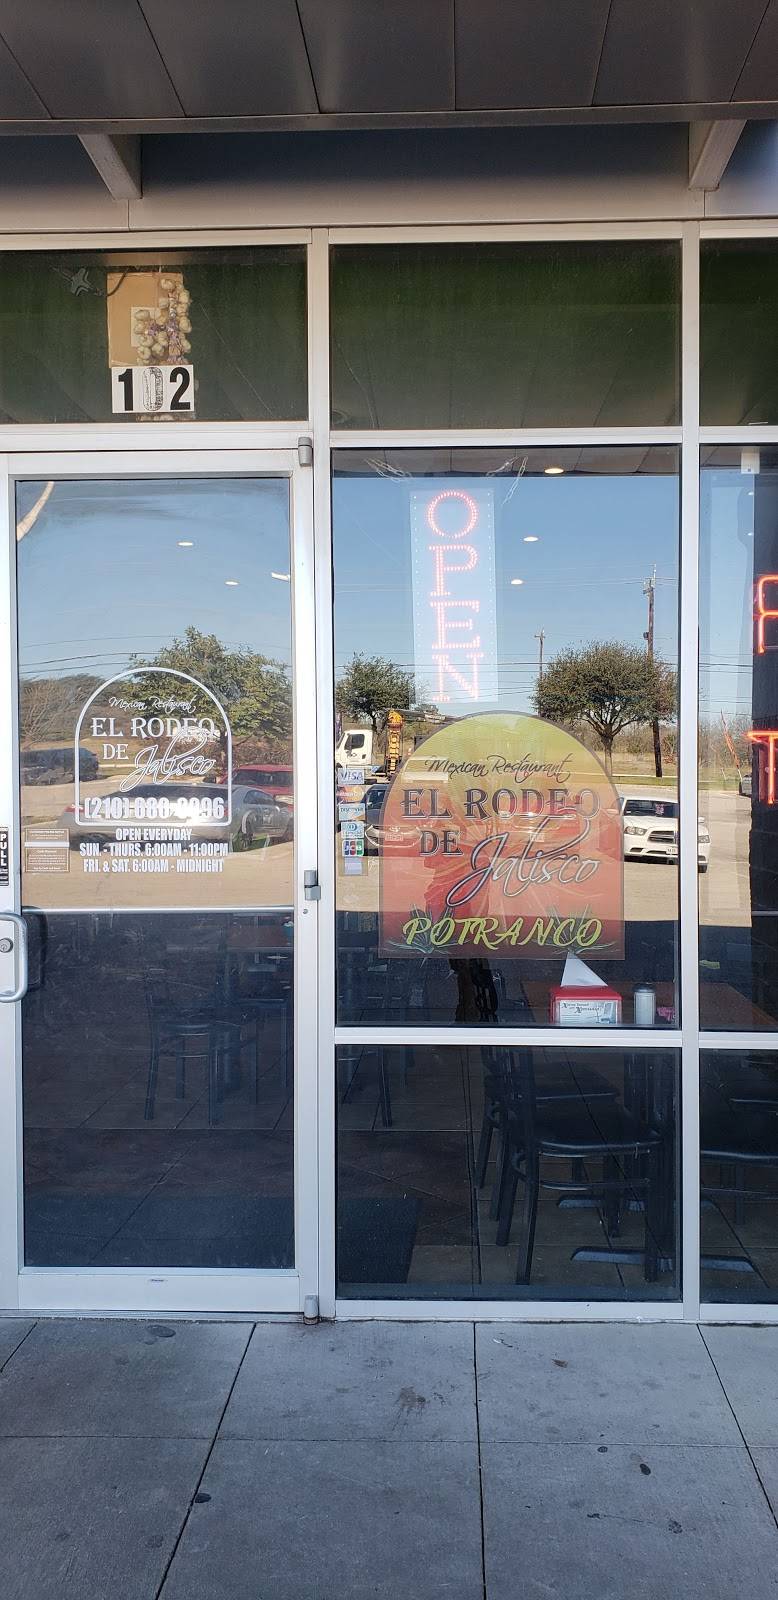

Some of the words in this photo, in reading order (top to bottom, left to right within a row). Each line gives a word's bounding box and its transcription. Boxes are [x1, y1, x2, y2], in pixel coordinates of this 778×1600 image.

[117, 366, 191, 412] 102
[425, 488, 484, 702] OPEN
[108, 696, 148, 712] Mexican
[149, 695, 196, 714] Restaurant
[90, 717, 123, 737] EL
[131, 717, 216, 739] RODEO
[103, 743, 129, 760] DE
[120, 728, 216, 792] Jalisco
[340, 771, 364, 781] VISA
[424, 758, 488, 780] Mexican
[487, 753, 573, 783] Restaurant
[400, 788, 452, 820] EL
[464, 788, 600, 820] RODEO
[115, 828, 142, 841] OPEN
[143, 828, 192, 841] EVERYDAY
[419, 829, 464, 857] DE
[0, 833, 8, 866] PULL
[79, 842, 102, 857] SUN.
[110, 842, 144, 857] THURS.
[145, 842, 182, 857] 6:00AM
[189, 842, 229, 857] 11:00PM
[446, 815, 600, 907] Jalisco
[83, 858, 101, 873] FRI.
[102, 860, 110, 873] &
[111, 858, 131, 873] SAT.
[132, 858, 169, 873] 6:00AM
[176, 858, 224, 873] MIDNIGHT
[402, 917, 603, 950] POTRANCO
